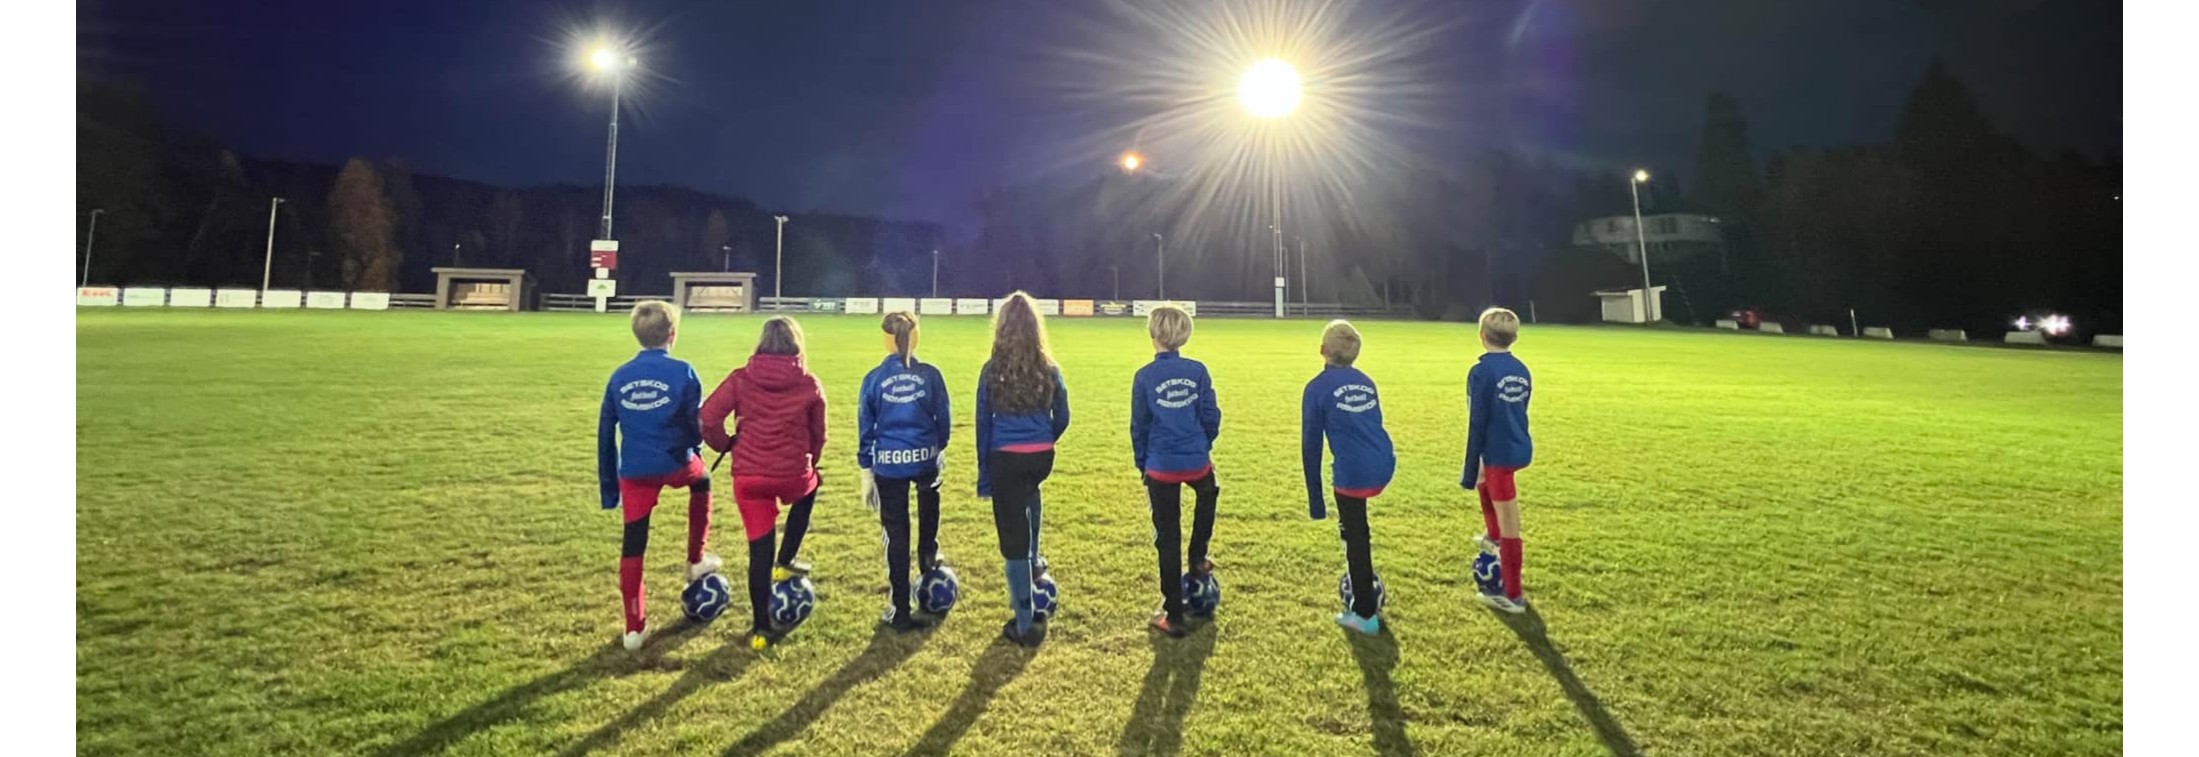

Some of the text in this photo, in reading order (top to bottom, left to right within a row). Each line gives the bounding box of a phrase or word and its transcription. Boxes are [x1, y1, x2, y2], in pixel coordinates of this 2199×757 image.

[620, 380, 668, 393] SETSKOG
[1156, 379, 1197, 393] SETSKOG
[632, 391, 657, 401] fotball
